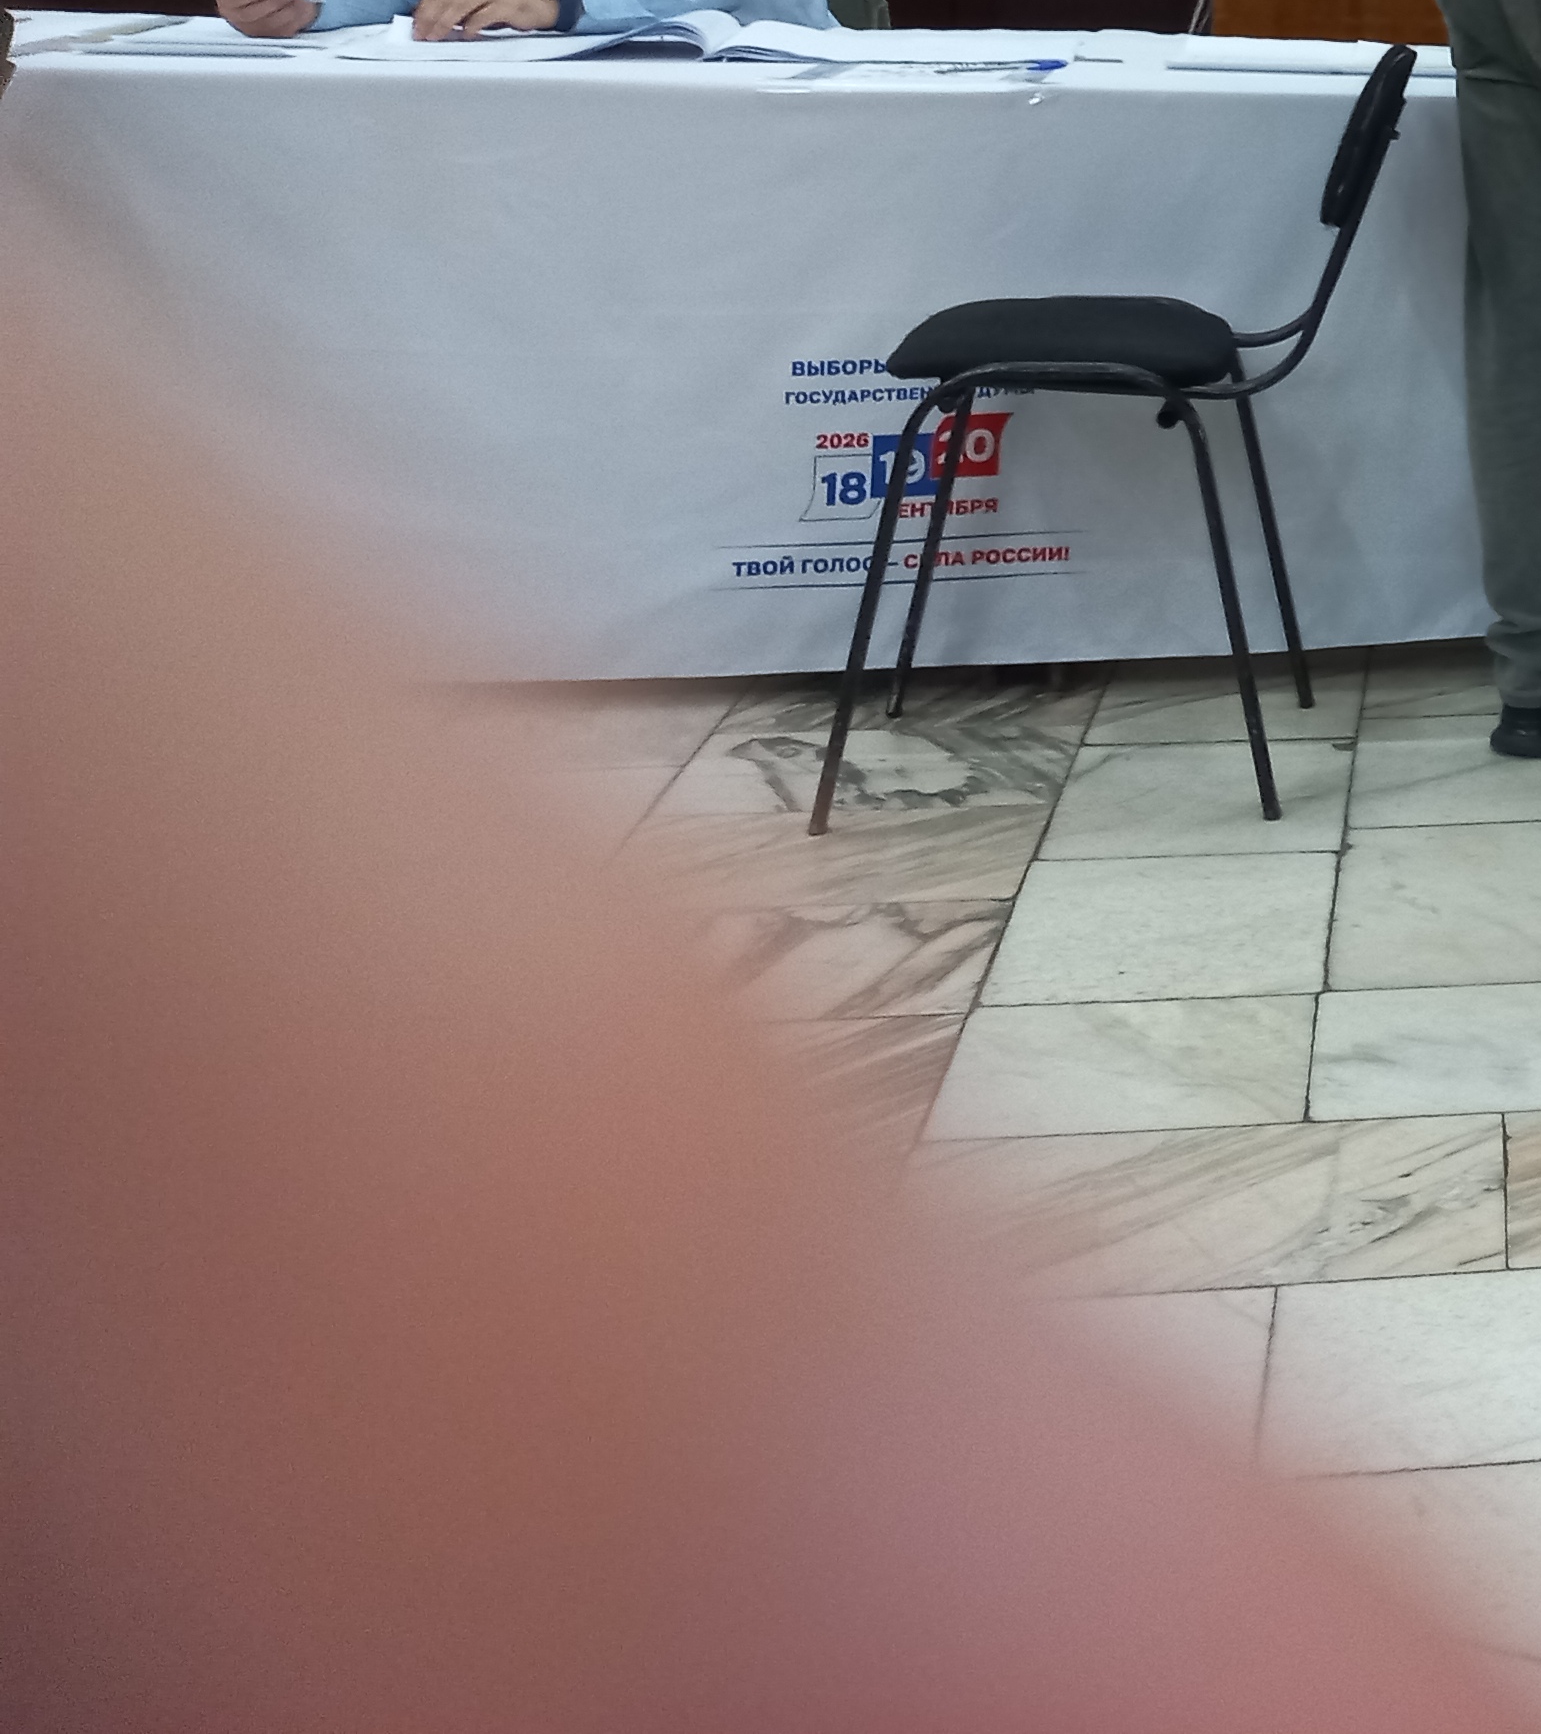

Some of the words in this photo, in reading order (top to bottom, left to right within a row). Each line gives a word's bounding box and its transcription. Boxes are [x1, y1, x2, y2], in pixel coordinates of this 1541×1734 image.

[815, 432, 870, 449] 2026
[821, 471, 868, 506] 18
[732, 556, 795, 578] ТВОЙ
[903, 551, 964, 570] СЛА
[971, 546, 1071, 566] РОССИИ!
